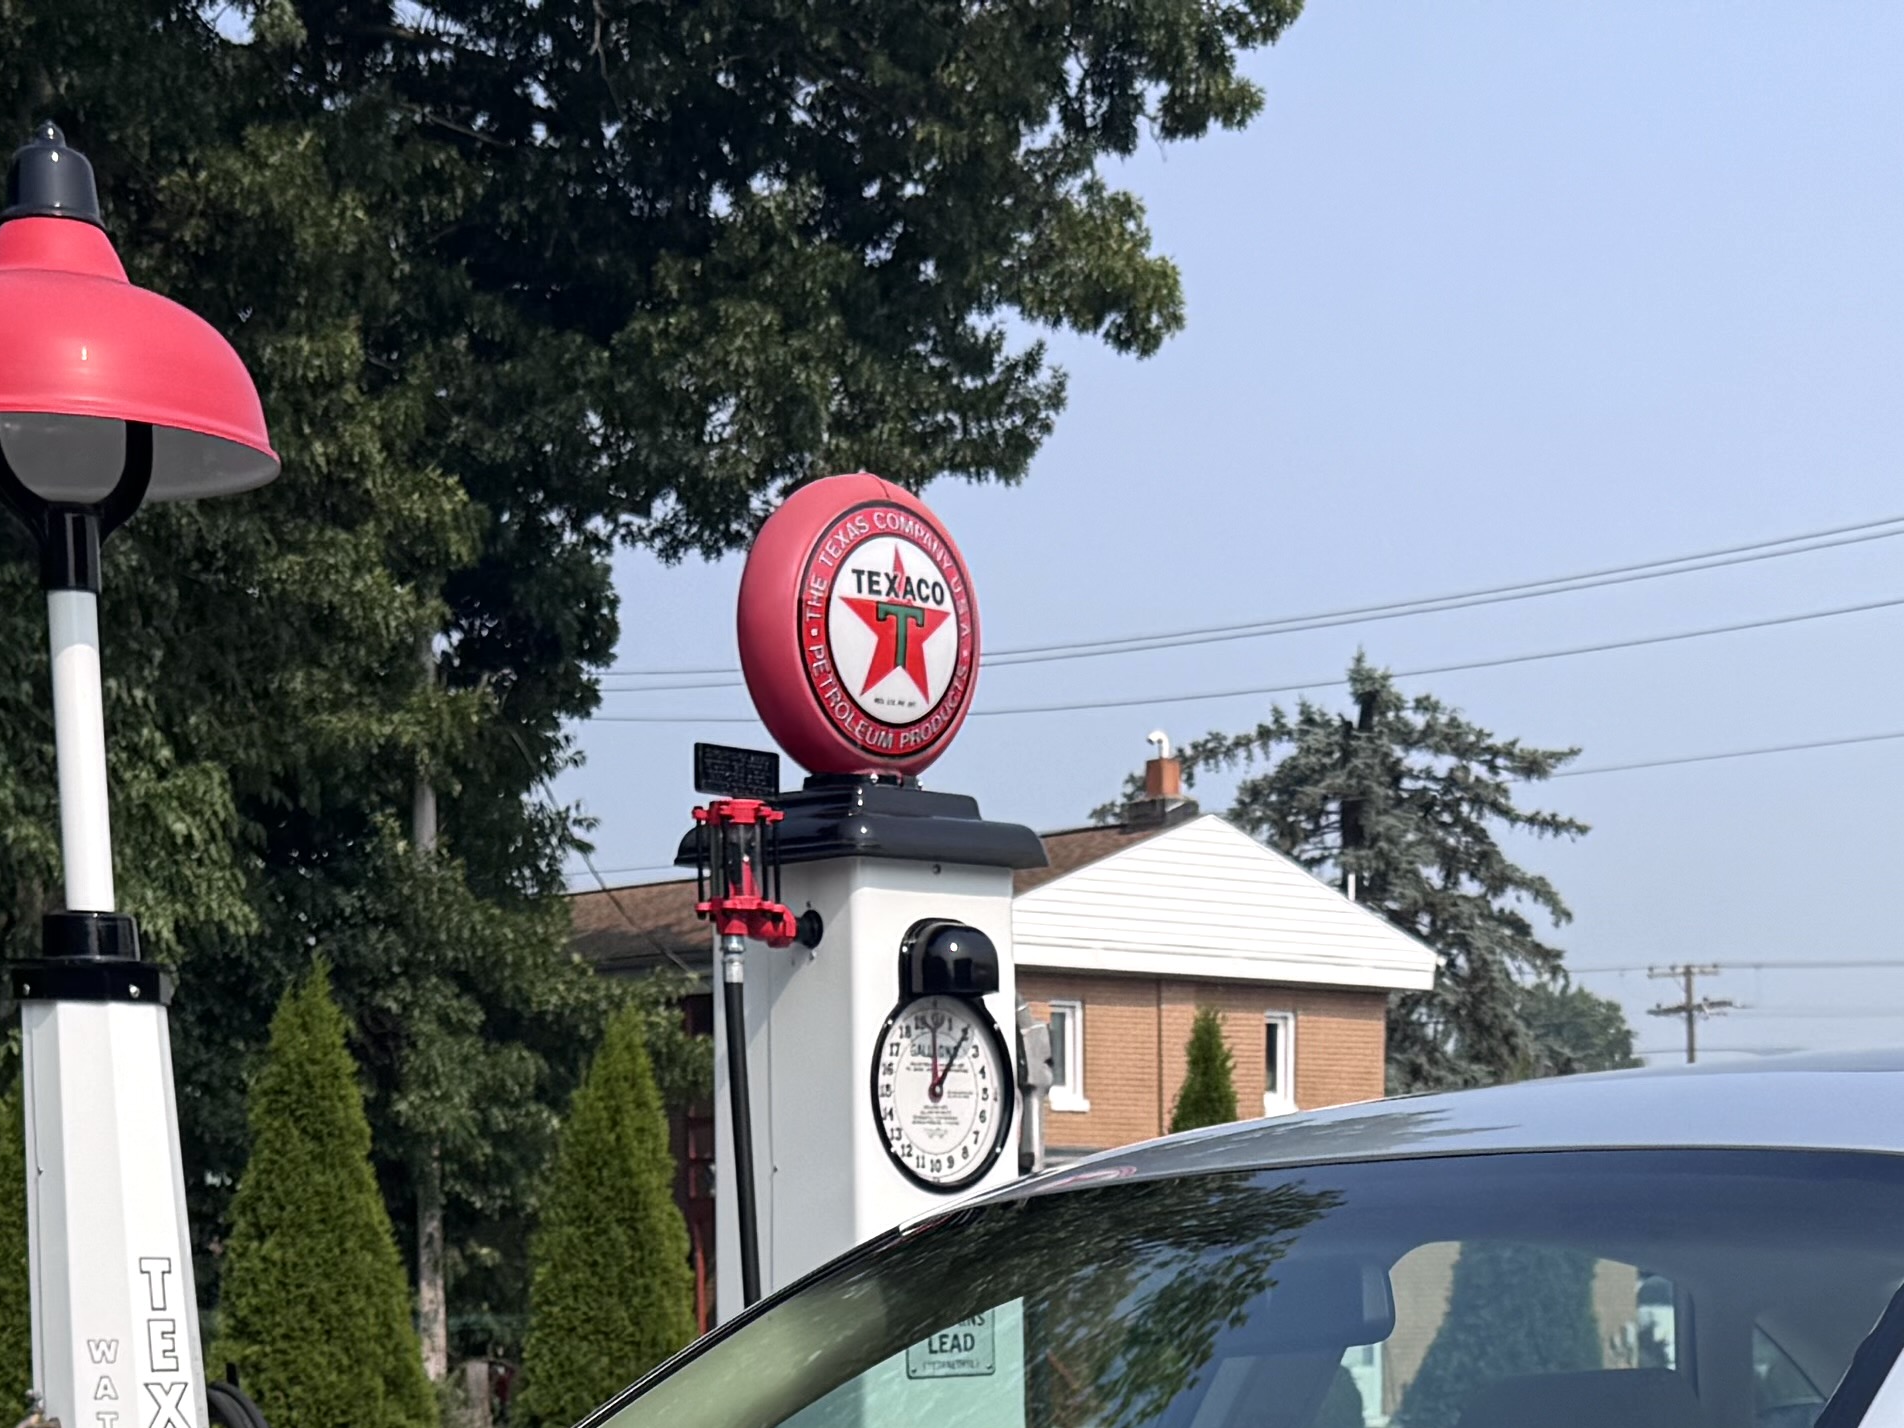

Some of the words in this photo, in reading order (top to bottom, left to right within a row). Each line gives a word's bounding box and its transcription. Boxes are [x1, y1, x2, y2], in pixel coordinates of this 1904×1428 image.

[806, 574, 828, 622] THE
[818, 515, 870, 568] TEXAS
[851, 568, 945, 606] TEXACO
[876, 601, 925, 669] T
[809, 644, 894, 750] PETROLEUM
[889, 1043, 901, 1057] 17
[971, 1045, 980, 1059] 3
[979, 1065, 986, 1080] 4
[972, 1130, 980, 1145] 7
[900, 1143, 913, 1158] 12
[930, 1158, 942, 1173] 10
[947, 1155, 955, 1169] 9
[928, 1332, 976, 1354] LEAD
